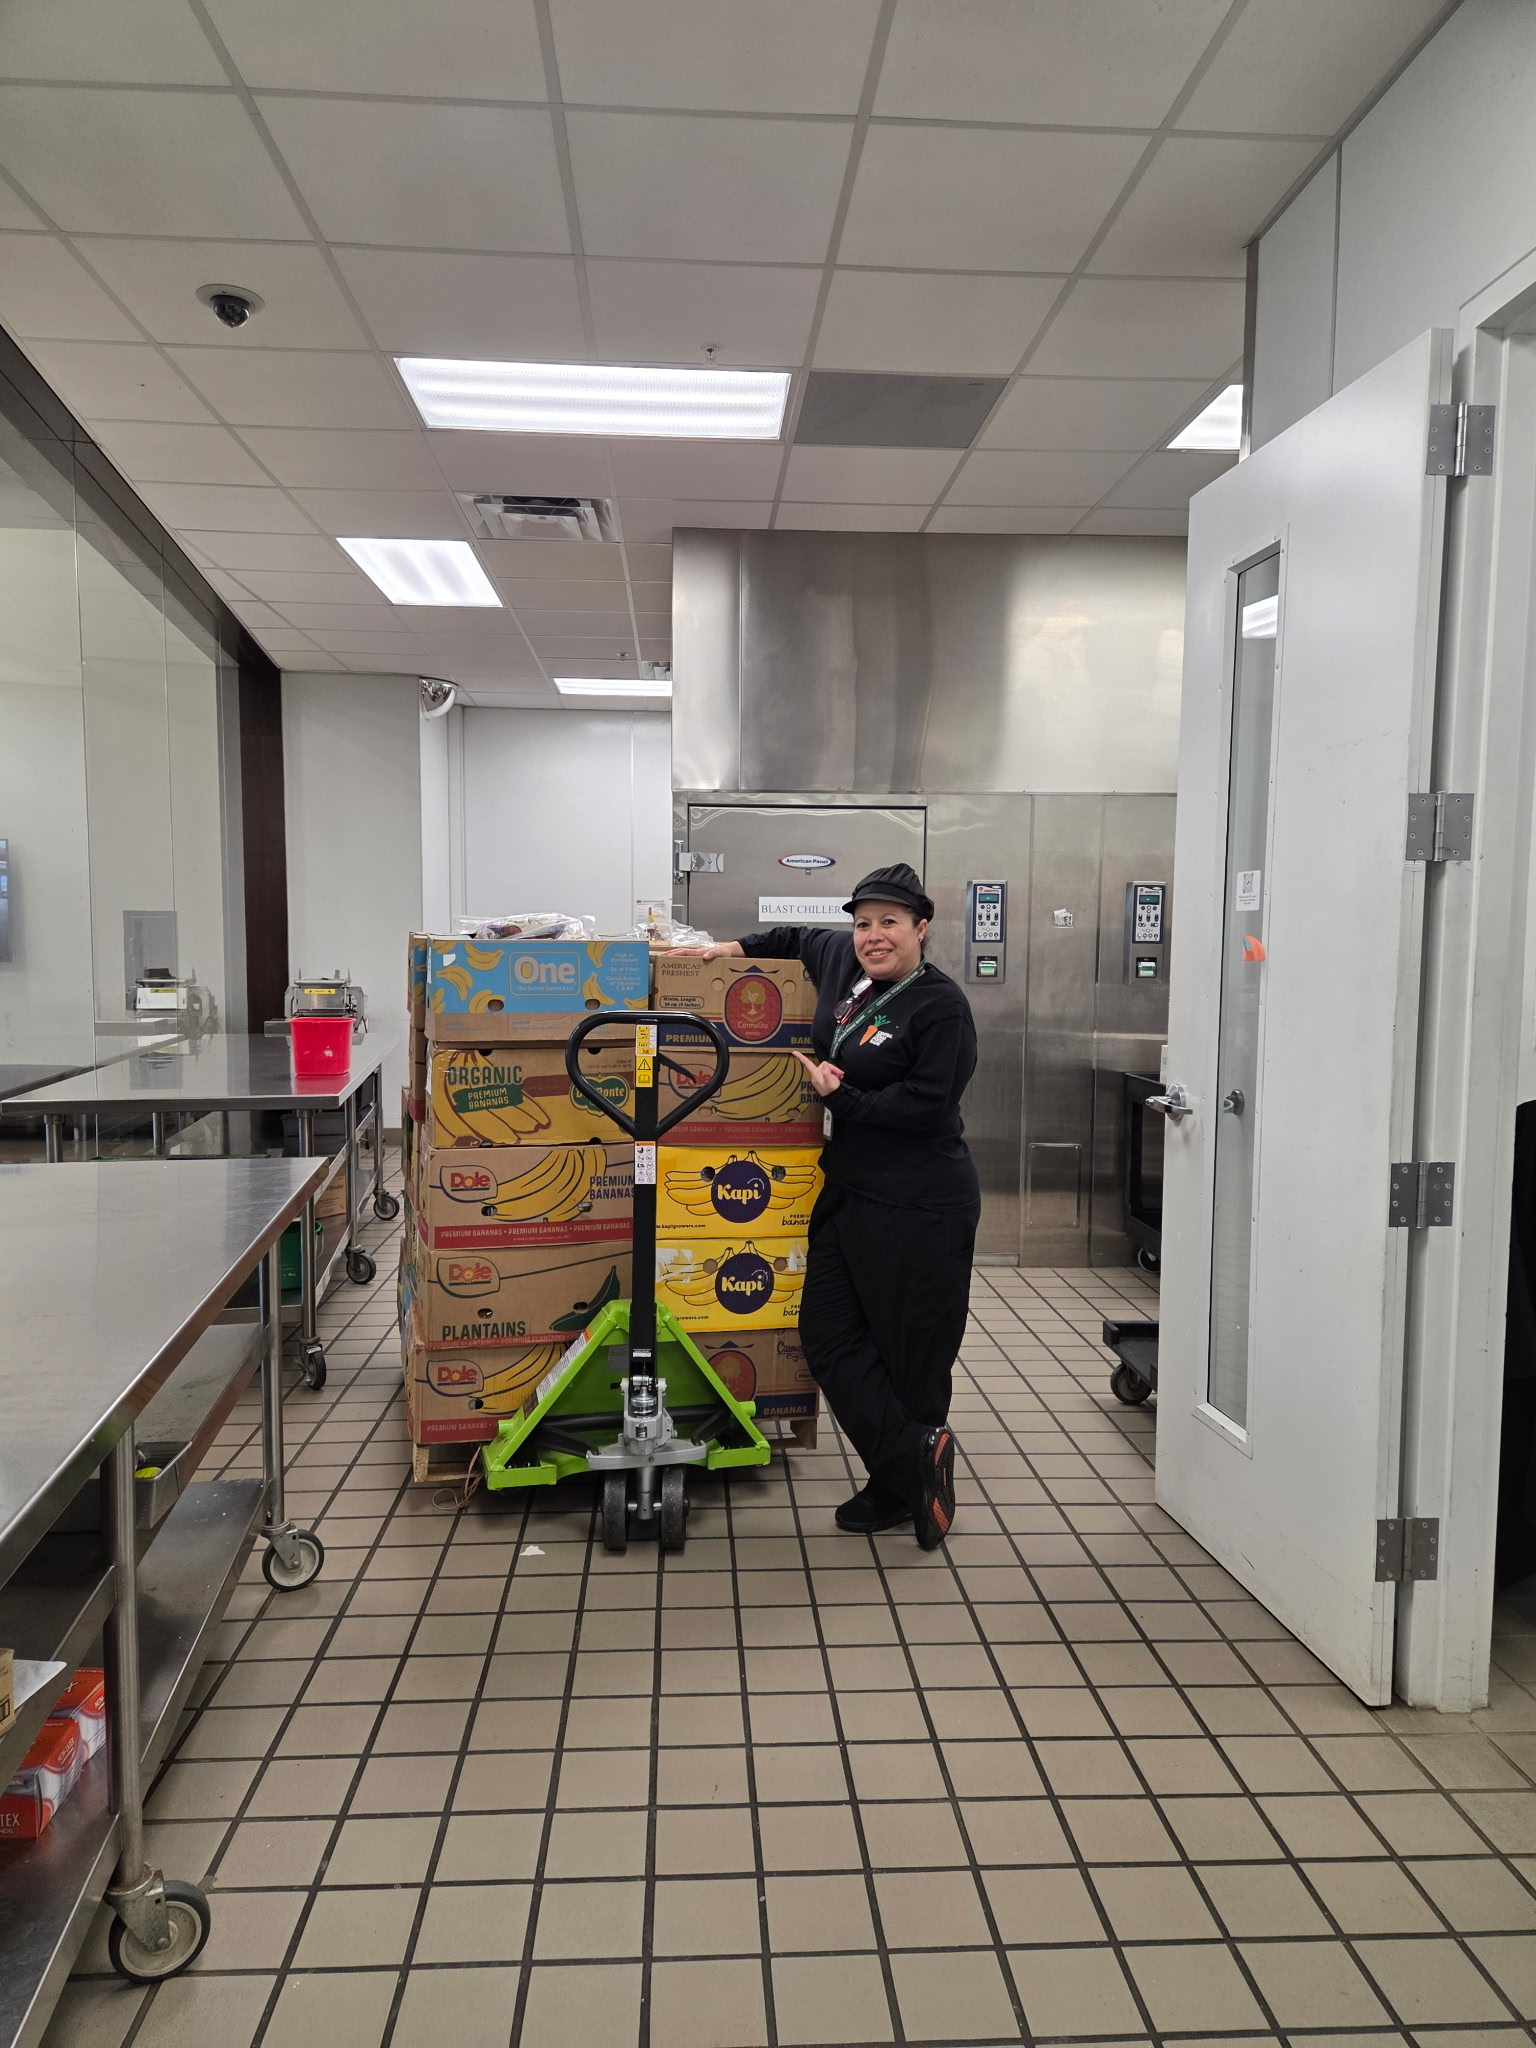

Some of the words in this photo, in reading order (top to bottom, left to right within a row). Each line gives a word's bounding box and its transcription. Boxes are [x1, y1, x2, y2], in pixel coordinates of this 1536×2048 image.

[761, 904, 794, 914] BLAST
[797, 904, 841, 914] CHILLER
[514, 956, 576, 984] One
[662, 969, 699, 977] FRESHEST
[737, 1021, 768, 1030] Carmelita
[448, 1065, 523, 1086] ORGANIC
[467, 1087, 508, 1101] PREMIUM
[468, 1095, 509, 1110] BANANAS
[451, 1171, 490, 1188] Dole
[717, 1183, 762, 1206] Kapi
[440, 1229, 471, 1238] PREMIUM
[472, 1228, 502, 1237] BANANAS
[508, 1227, 538, 1235] PREMIUM
[539, 1225, 568, 1234] BANANAS
[573, 1224, 602, 1232] PREMIUM
[603, 1222, 631, 1230] BANANAS
[449, 1262, 492, 1282] Dole
[721, 1274, 765, 1297] Kapi
[442, 1320, 526, 1342] PLANTAINS
[437, 1365, 478, 1383] Dole
[763, 1405, 808, 1416] BANANAS
[427, 1424, 457, 1432] PREMIUM
[458, 1423, 488, 1431] BANANAS
